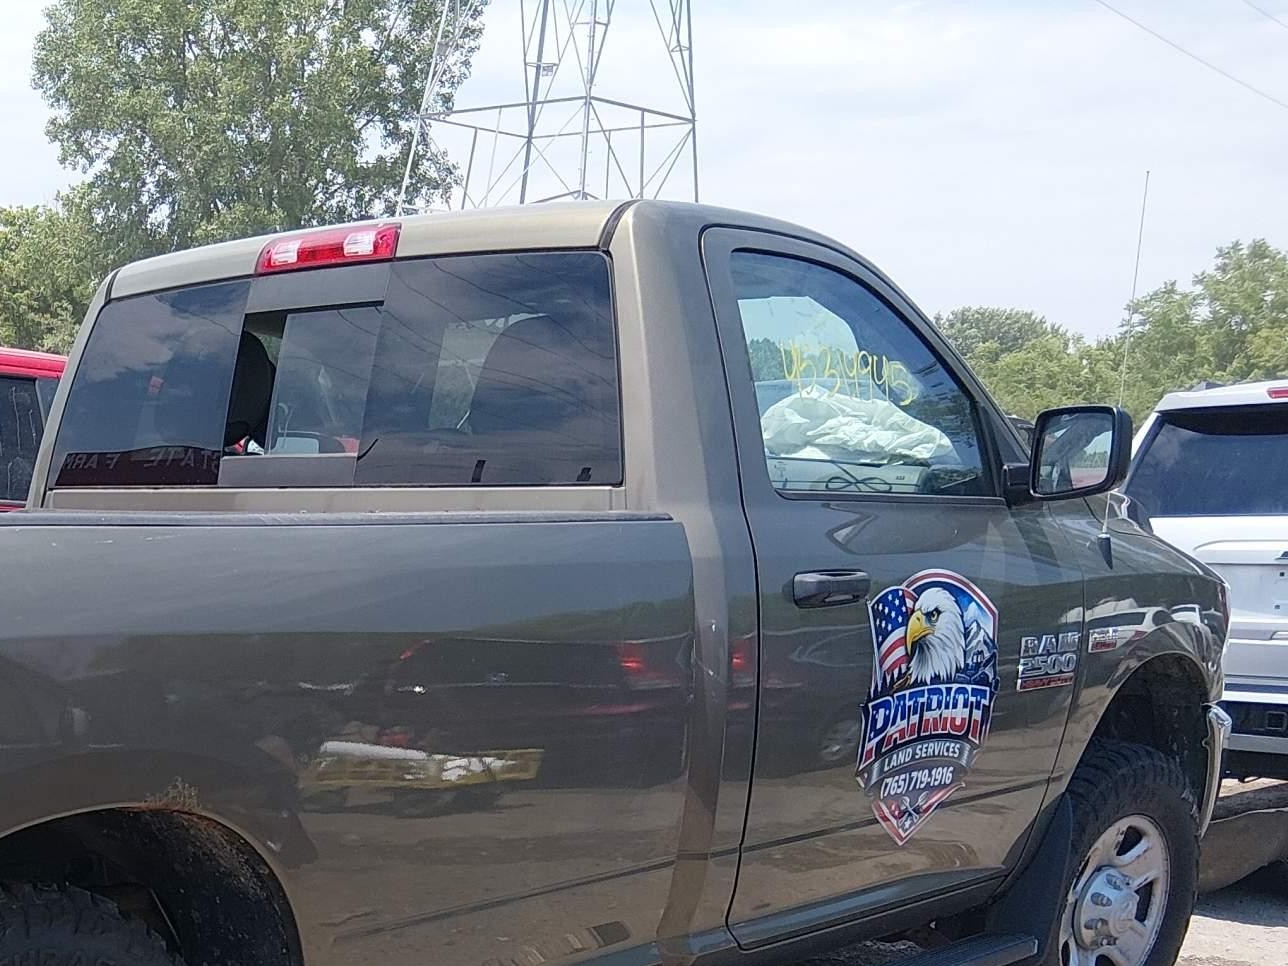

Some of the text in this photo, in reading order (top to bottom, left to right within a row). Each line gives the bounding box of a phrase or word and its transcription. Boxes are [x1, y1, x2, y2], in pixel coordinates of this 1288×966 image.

[1020, 632, 1081, 656] RAM
[1018, 652, 1077, 677] 2500
[858, 684, 990, 771] PATRIOT
[883, 741, 961, 772] LAND SERVICES
[880, 766, 954, 800] (765) 719-1916
